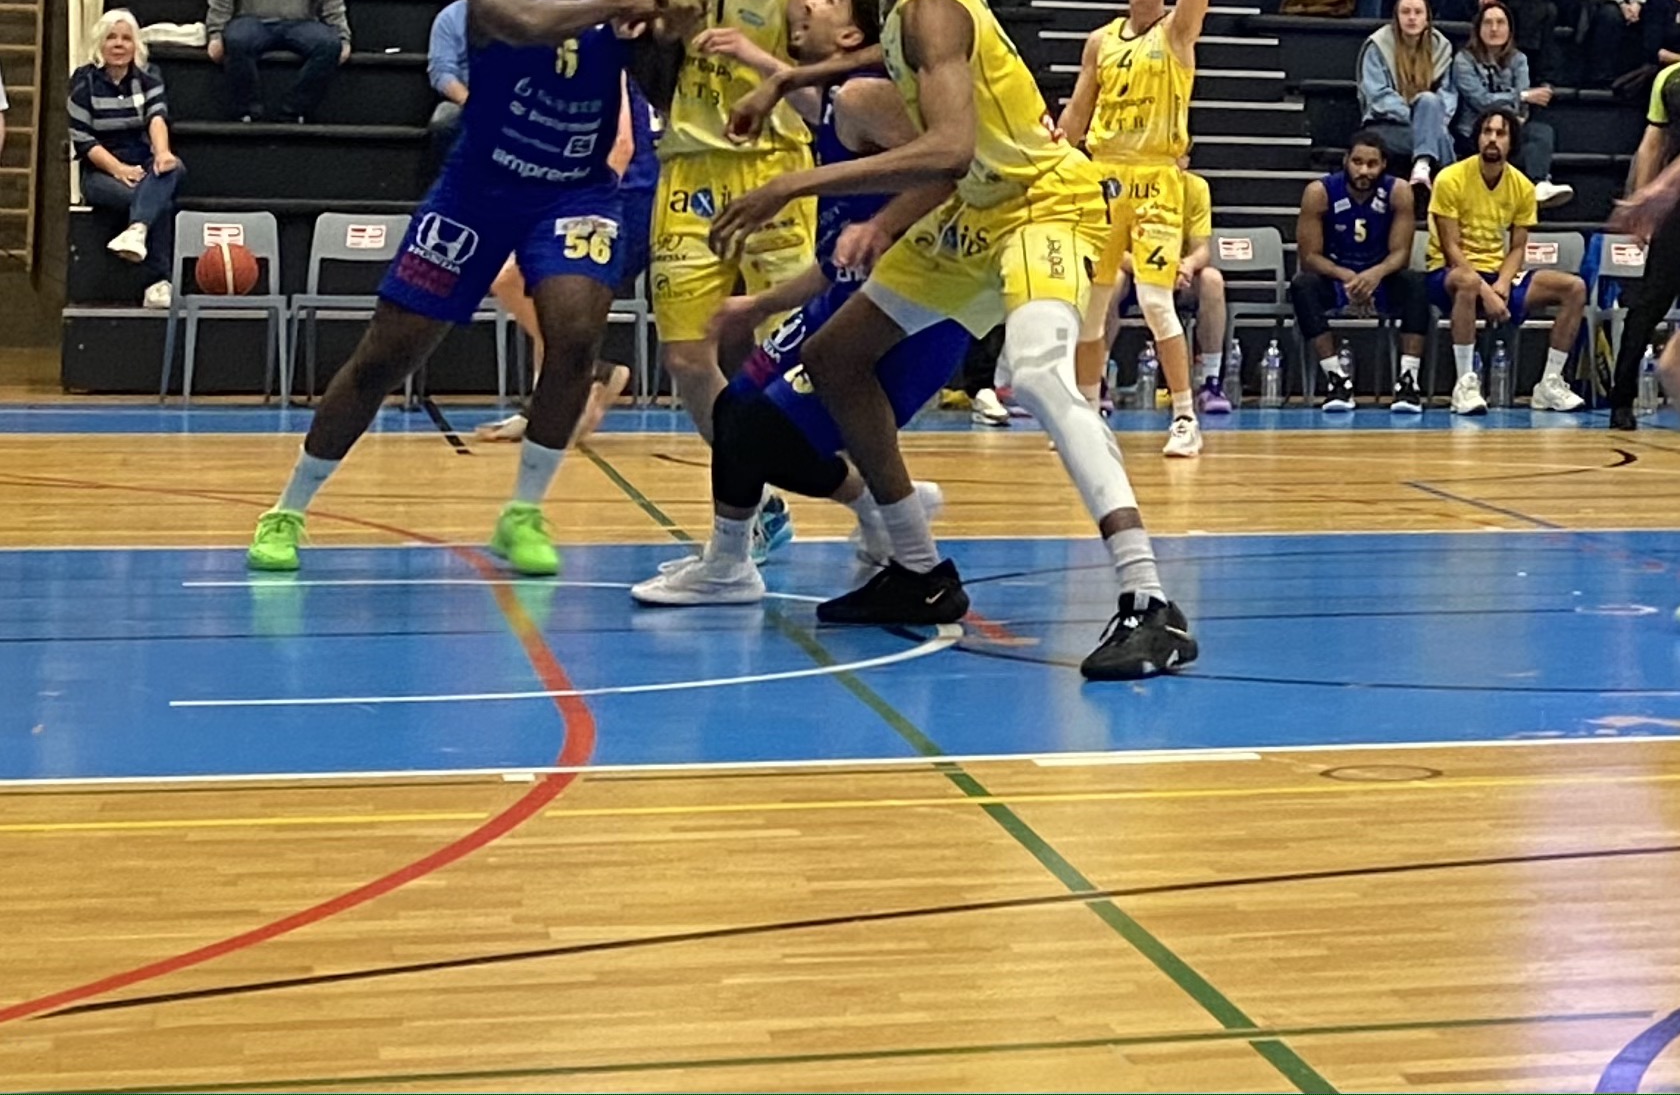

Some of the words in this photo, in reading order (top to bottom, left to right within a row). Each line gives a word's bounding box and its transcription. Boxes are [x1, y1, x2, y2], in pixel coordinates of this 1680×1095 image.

[1353, 218, 1368, 243] 5
[563, 229, 612, 265] 56
[1146, 246, 1168, 271] 4
